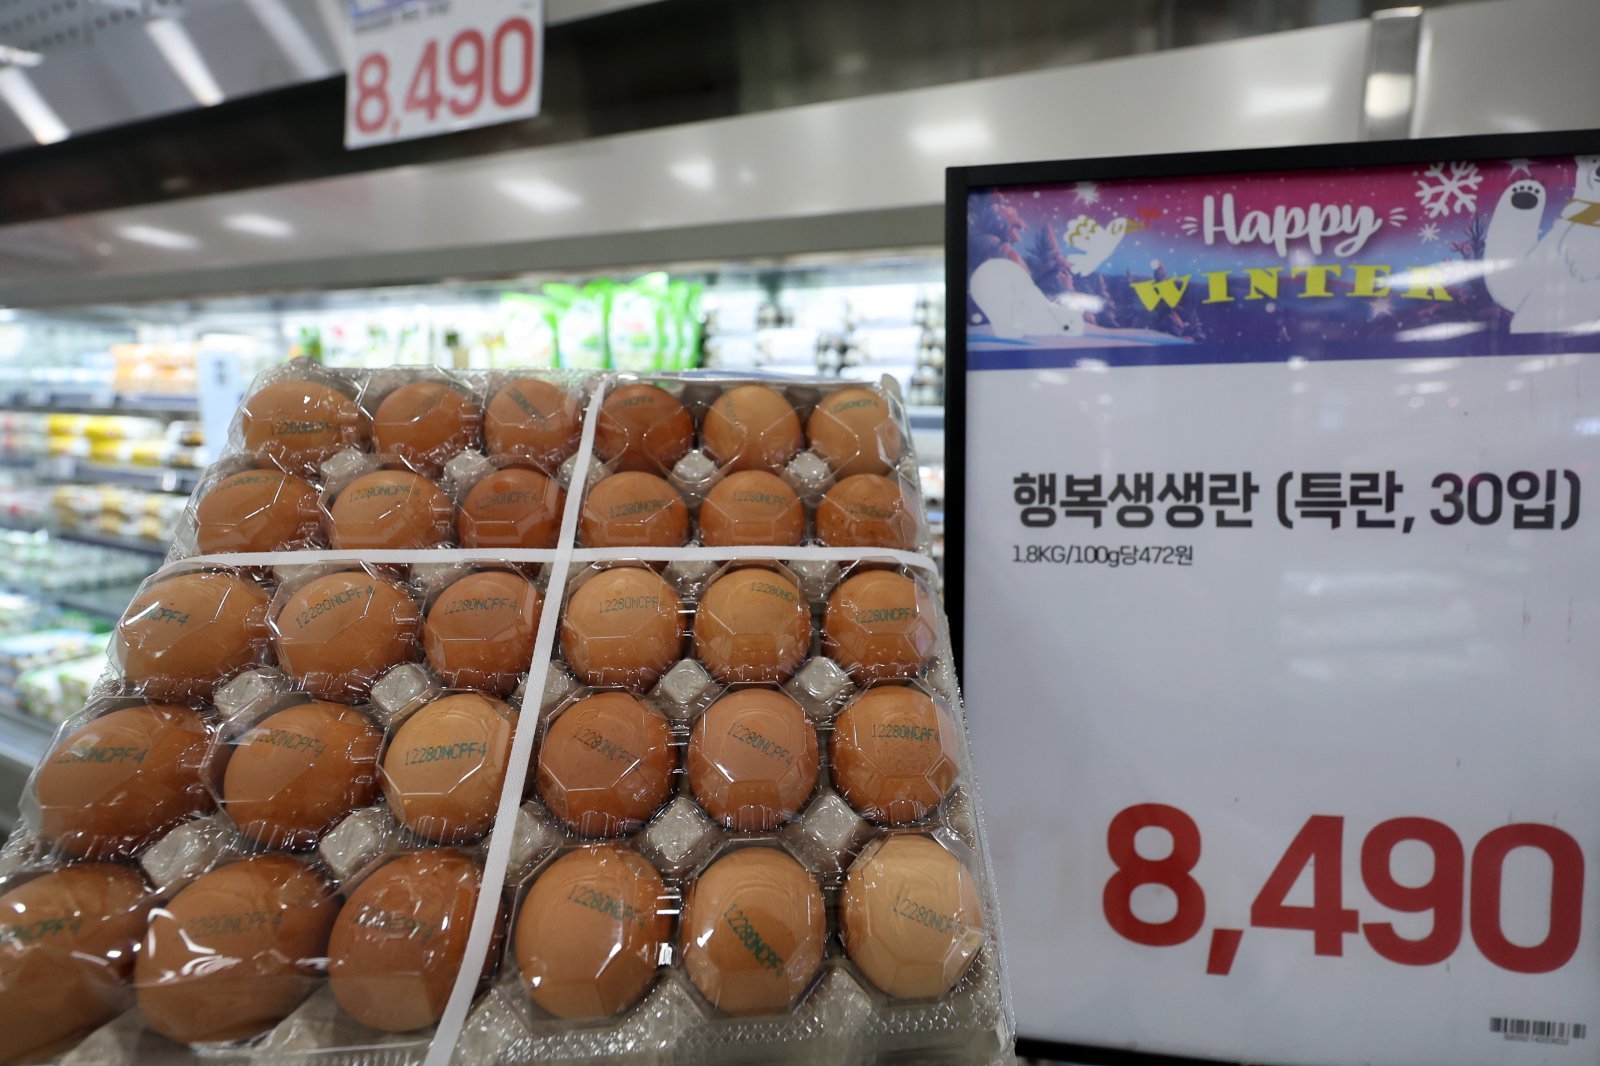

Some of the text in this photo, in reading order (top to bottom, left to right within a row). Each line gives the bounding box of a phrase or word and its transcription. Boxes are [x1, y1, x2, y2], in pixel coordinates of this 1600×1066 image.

[354, 15, 535, 138] 8,490
[1203, 193, 1382, 257] Happy
[1131, 264, 1454, 313] WINTER
[1013, 469, 1581, 533] 행복생생란 (특란, 30입)
[1012, 545, 1194, 568] 1.8KG/100g당472원
[1102, 802, 1586, 977] 8,490
